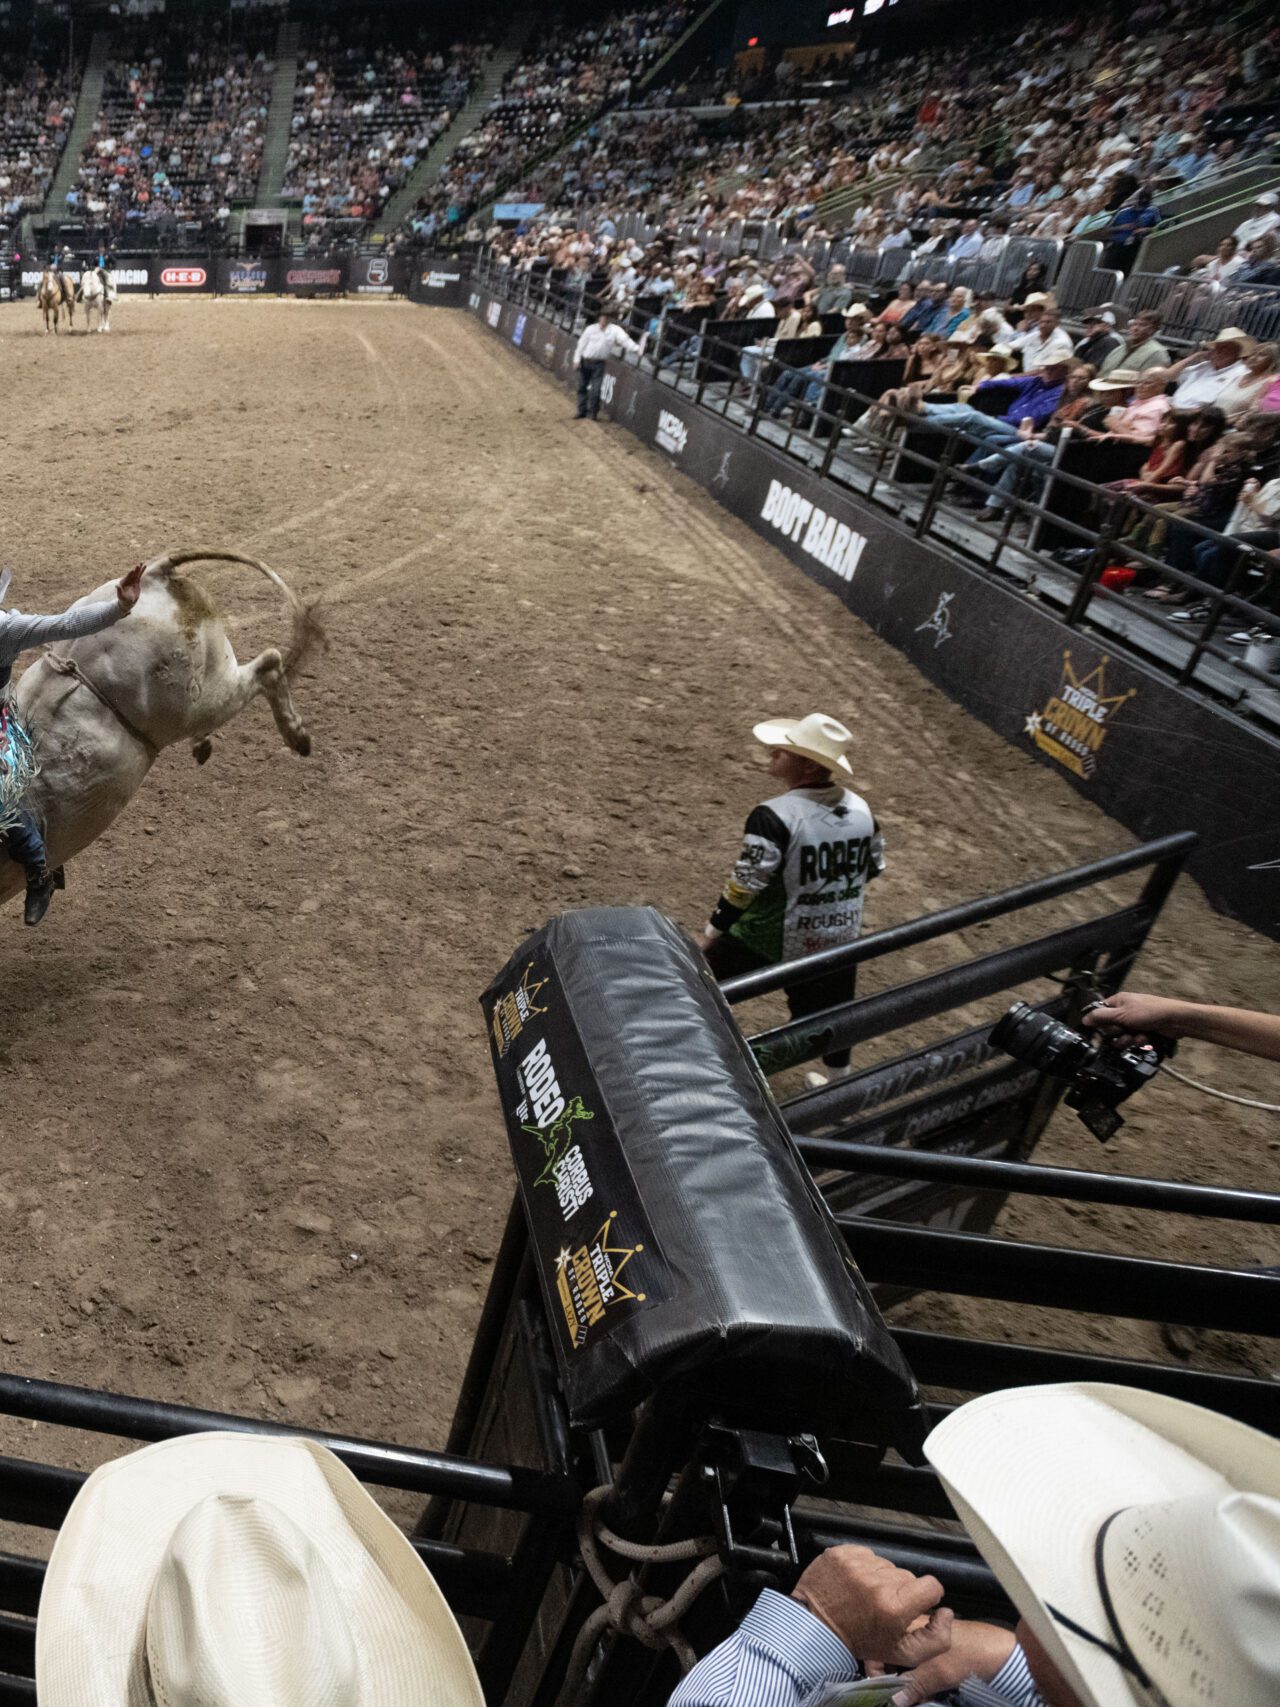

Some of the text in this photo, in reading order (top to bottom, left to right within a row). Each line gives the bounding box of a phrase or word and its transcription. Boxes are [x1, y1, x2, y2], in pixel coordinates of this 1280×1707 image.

[760, 479, 868, 583] BOOT BARN
[1043, 696, 1108, 752] CROWN
[1061, 685, 1109, 724] TRIPLE
[800, 836, 872, 886] RODEO
[502, 990, 524, 1041] CROWN
[515, 985, 530, 1023] TRIPLE
[516, 1099, 530, 1123] Lite
[521, 1037, 565, 1129] RODEO
[552, 1159, 580, 1222] CHRISTI
[565, 1144, 594, 1206] CORPUS
[571, 1244, 607, 1327] CROWN
[589, 1242, 615, 1303] TRIPLE
[603, 1252, 615, 1278] WCRA
[564, 1302, 575, 1329] LAZY
[567, 1267, 588, 1324] OF RODEO
